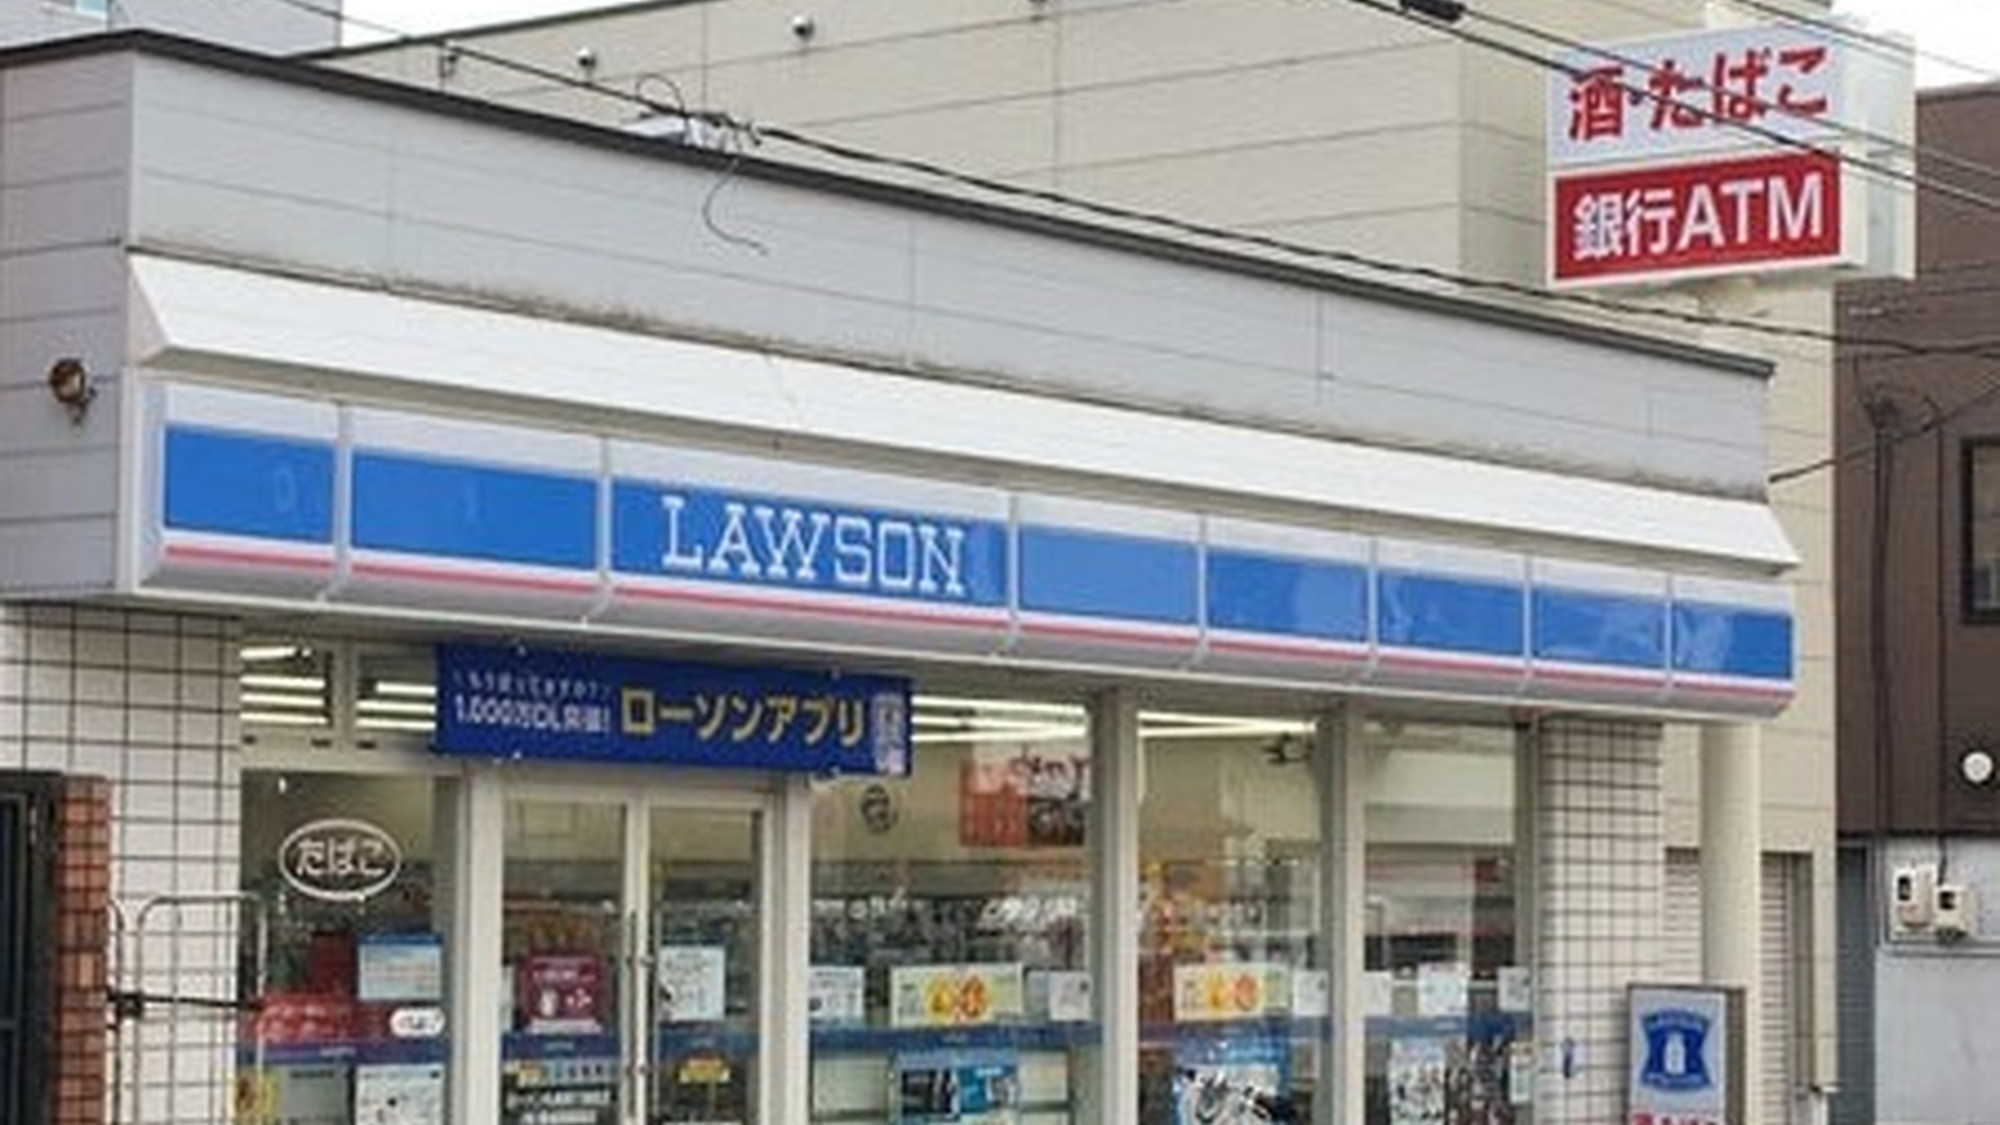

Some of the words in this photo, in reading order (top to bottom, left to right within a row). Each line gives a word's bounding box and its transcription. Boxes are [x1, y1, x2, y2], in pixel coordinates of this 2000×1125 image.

[1568, 46, 1828, 142] 酒・たばこ
[1572, 171, 1824, 262] 銀行ATM
[661, 495, 965, 597] LAWSON
[621, 685, 865, 747] ローソンアプリ
[296, 837, 387, 876] たばこ
